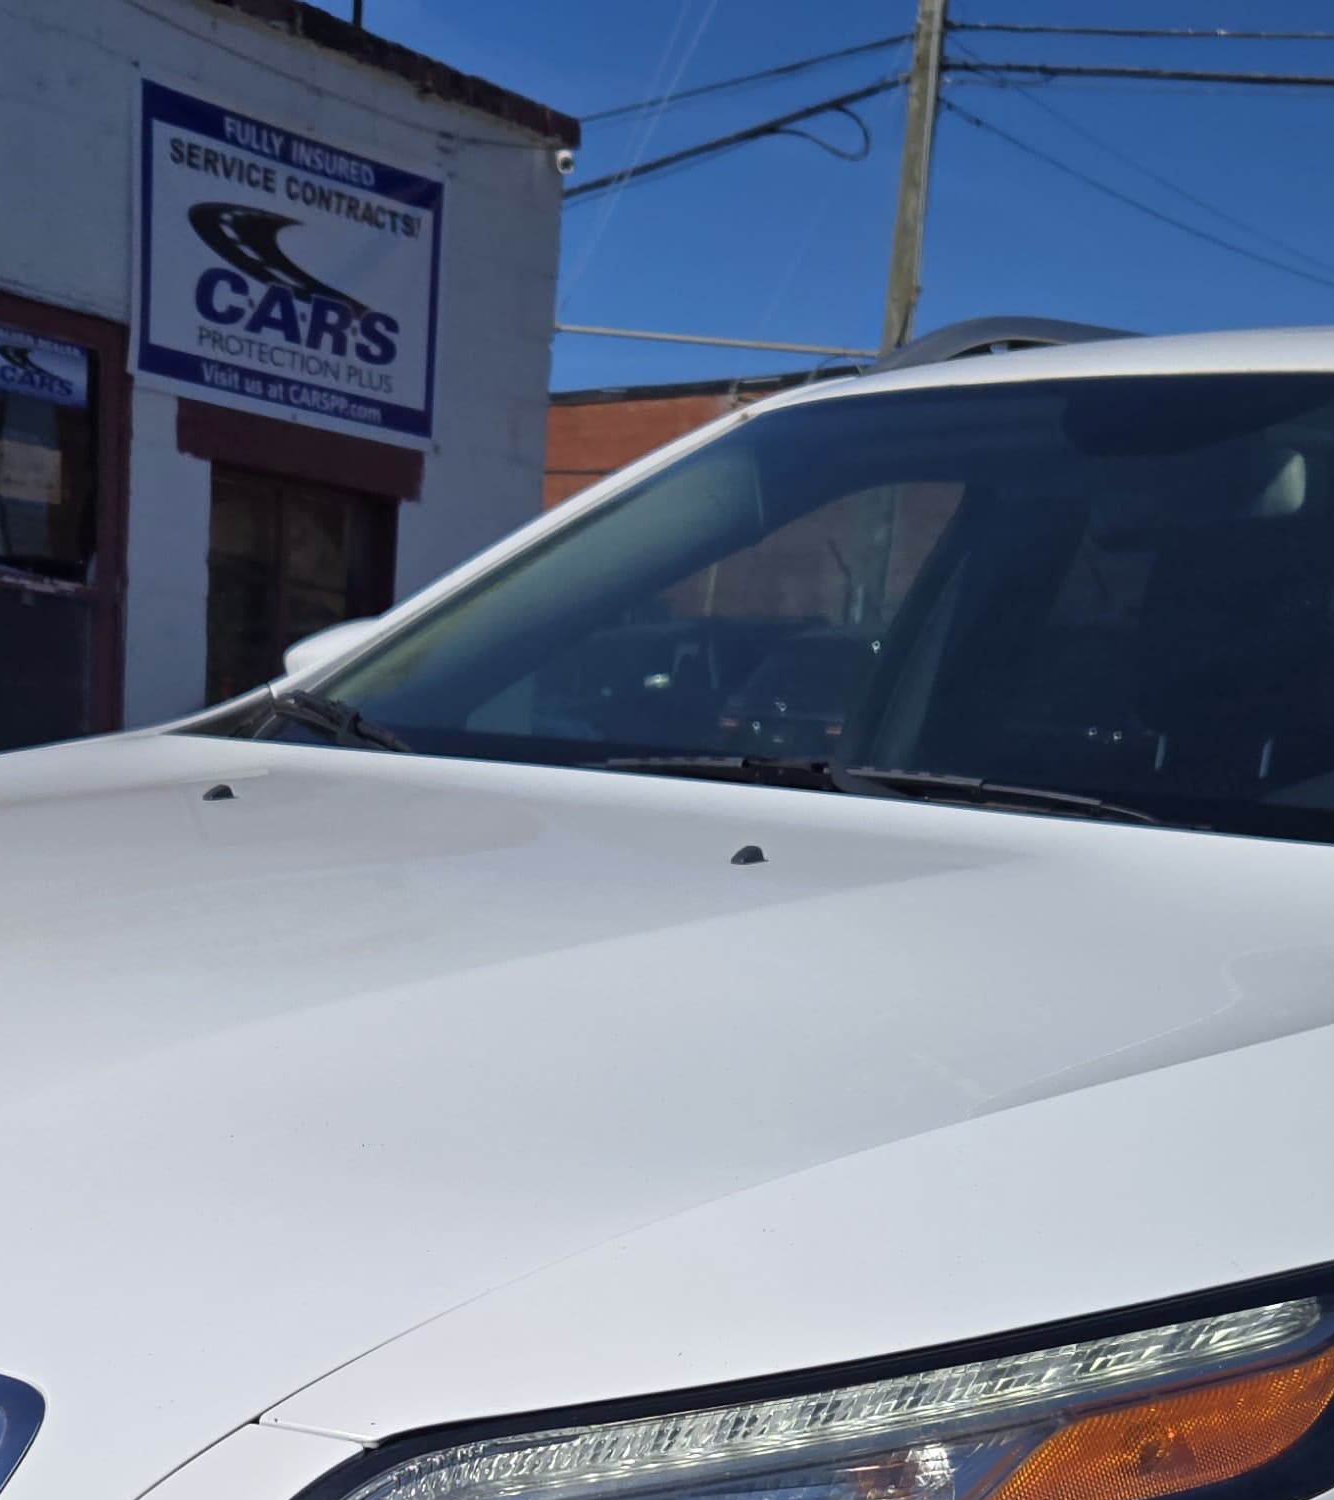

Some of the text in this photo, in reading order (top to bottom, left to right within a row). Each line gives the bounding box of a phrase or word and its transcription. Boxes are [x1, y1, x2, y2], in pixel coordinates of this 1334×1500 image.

[224, 116, 376, 188] FULLY INSURED
[170, 137, 422, 239] SERVICE CONTRACTS!
[198, 326, 394, 395] PROTECTION PLUS
[202, 362, 240, 391] Visit
[245, 376, 263, 394] us
[268, 381, 285, 400] at
